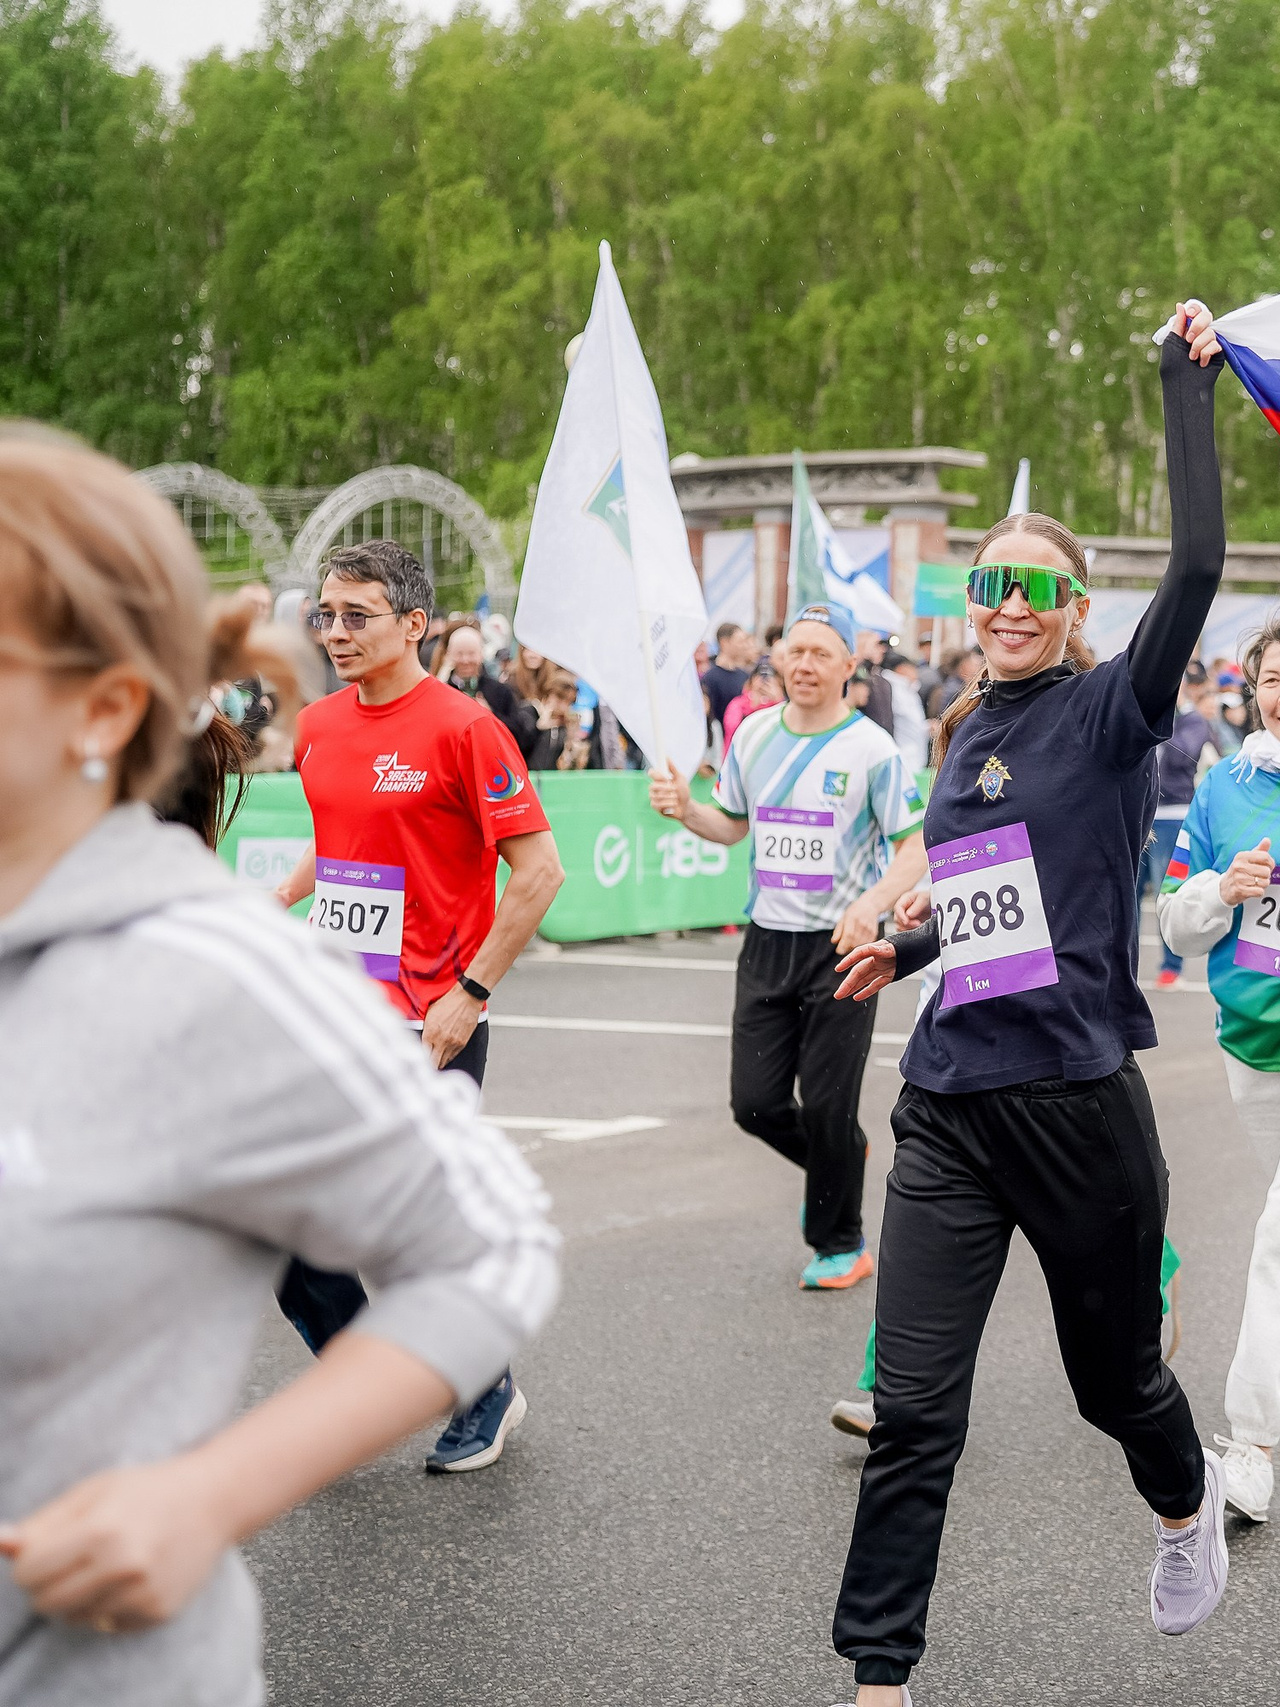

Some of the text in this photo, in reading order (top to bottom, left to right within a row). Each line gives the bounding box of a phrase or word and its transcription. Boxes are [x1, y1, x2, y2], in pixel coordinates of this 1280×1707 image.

[384, 770, 428, 782] ЗВЕЗДА
[377, 781, 425, 793] ПАМЯТИ
[765, 835, 823, 861] 2038
[318, 897, 390, 936] 2507
